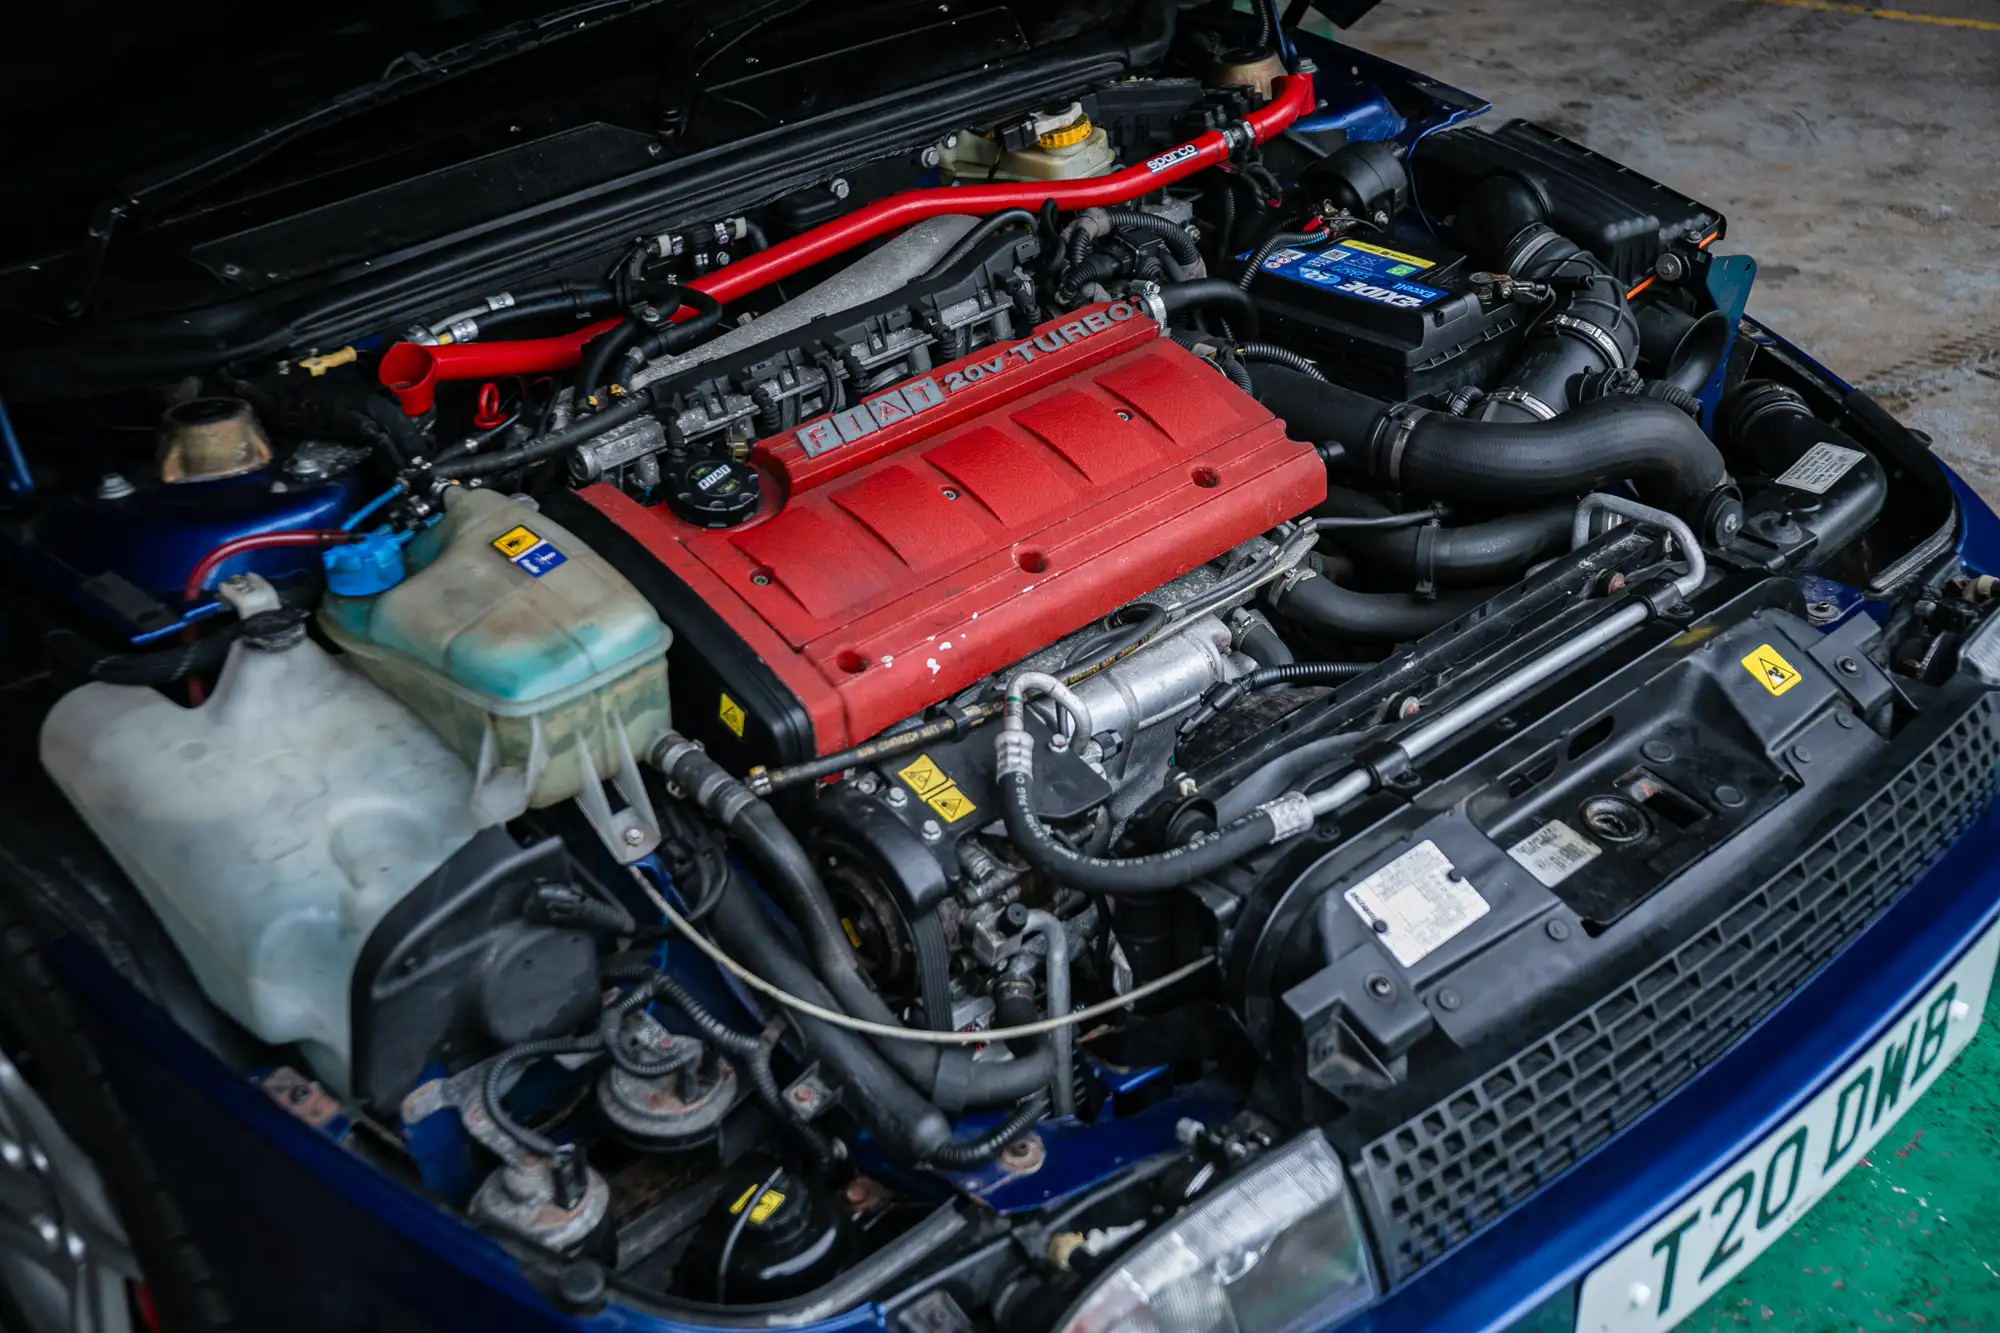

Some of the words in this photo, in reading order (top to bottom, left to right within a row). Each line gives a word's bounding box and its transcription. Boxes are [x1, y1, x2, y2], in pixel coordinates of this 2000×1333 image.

[1146, 144, 1196, 170] sparco
[1338, 281, 1423, 307] EXIDE
[1392, 282, 1437, 299] Excell
[796, 376, 946, 458] FIAT
[1009, 302, 1134, 363] TURBO
[697, 464, 732, 490] FIAT
[1651, 1125, 1809, 1316] T20
[1821, 981, 1957, 1179] DWB
